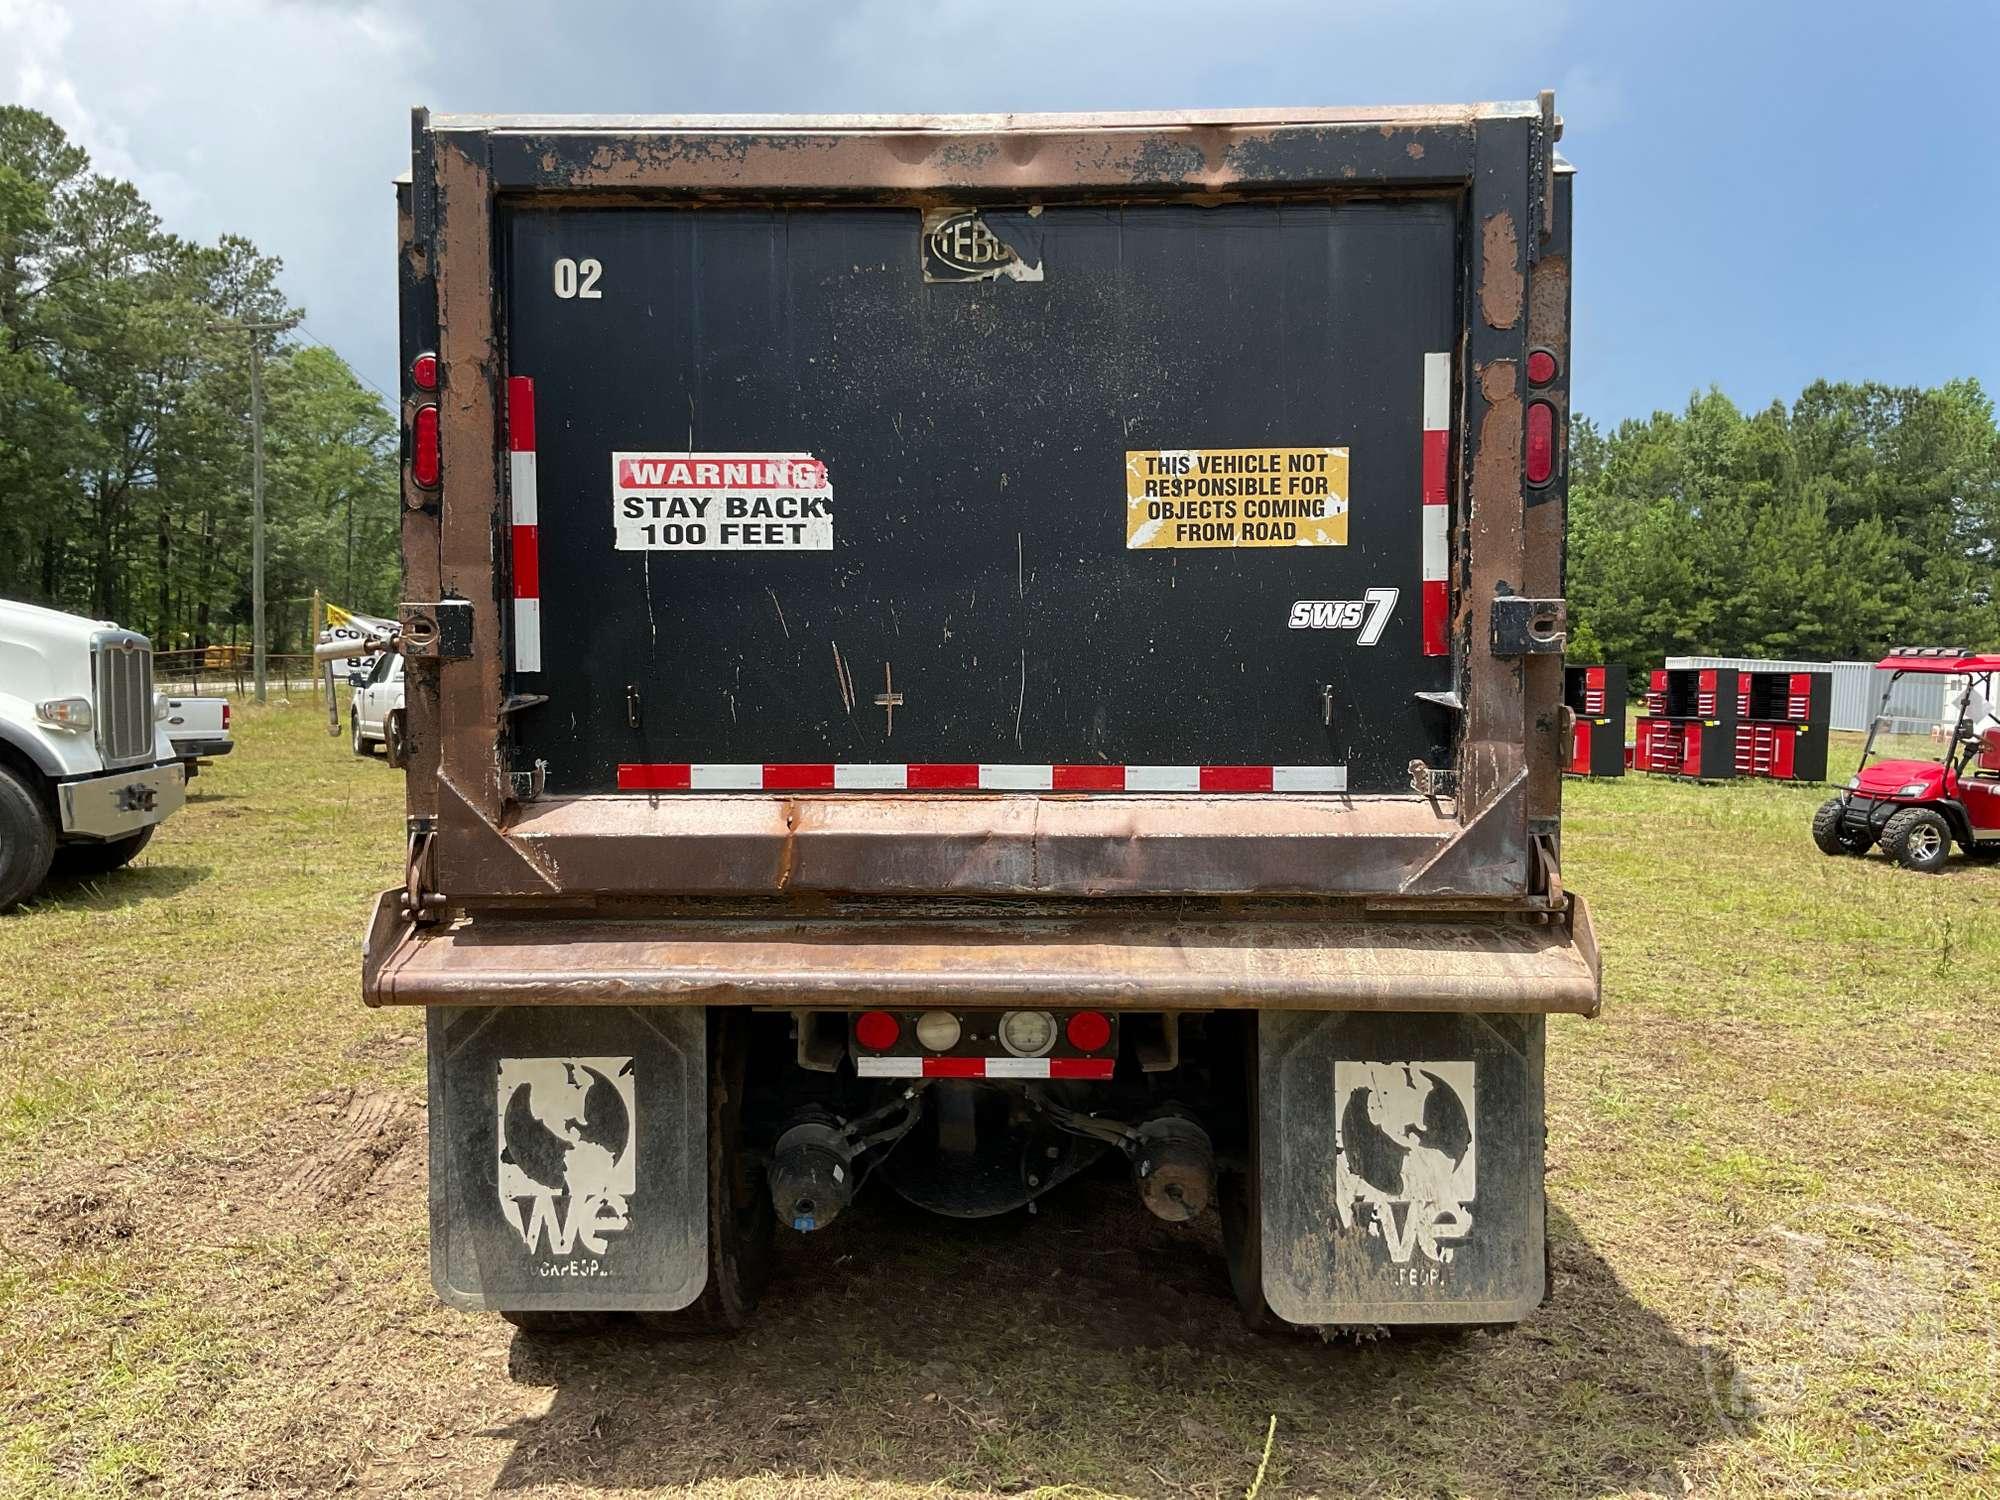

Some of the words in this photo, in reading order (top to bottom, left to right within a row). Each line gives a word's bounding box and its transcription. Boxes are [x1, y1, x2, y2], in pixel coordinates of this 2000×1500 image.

[554, 258, 602, 299] 02
[630, 463, 818, 486] WARNING
[1145, 456, 1190, 475] THIS
[1197, 454, 1281, 474] VEHICLE
[1288, 453, 1329, 473] NOT
[1145, 477, 1281, 498] RESPONSIBLE
[1288, 476, 1329, 495] FOR
[623, 496, 712, 519] STAY
[725, 496, 823, 518] BACK
[1147, 500, 1237, 520] OBJECTS
[1243, 499, 1325, 518] COMING
[641, 523, 707, 545] 100
[720, 523, 807, 544] FEET
[1176, 523, 1235, 542] FROM
[1242, 522, 1297, 541] ROAD
